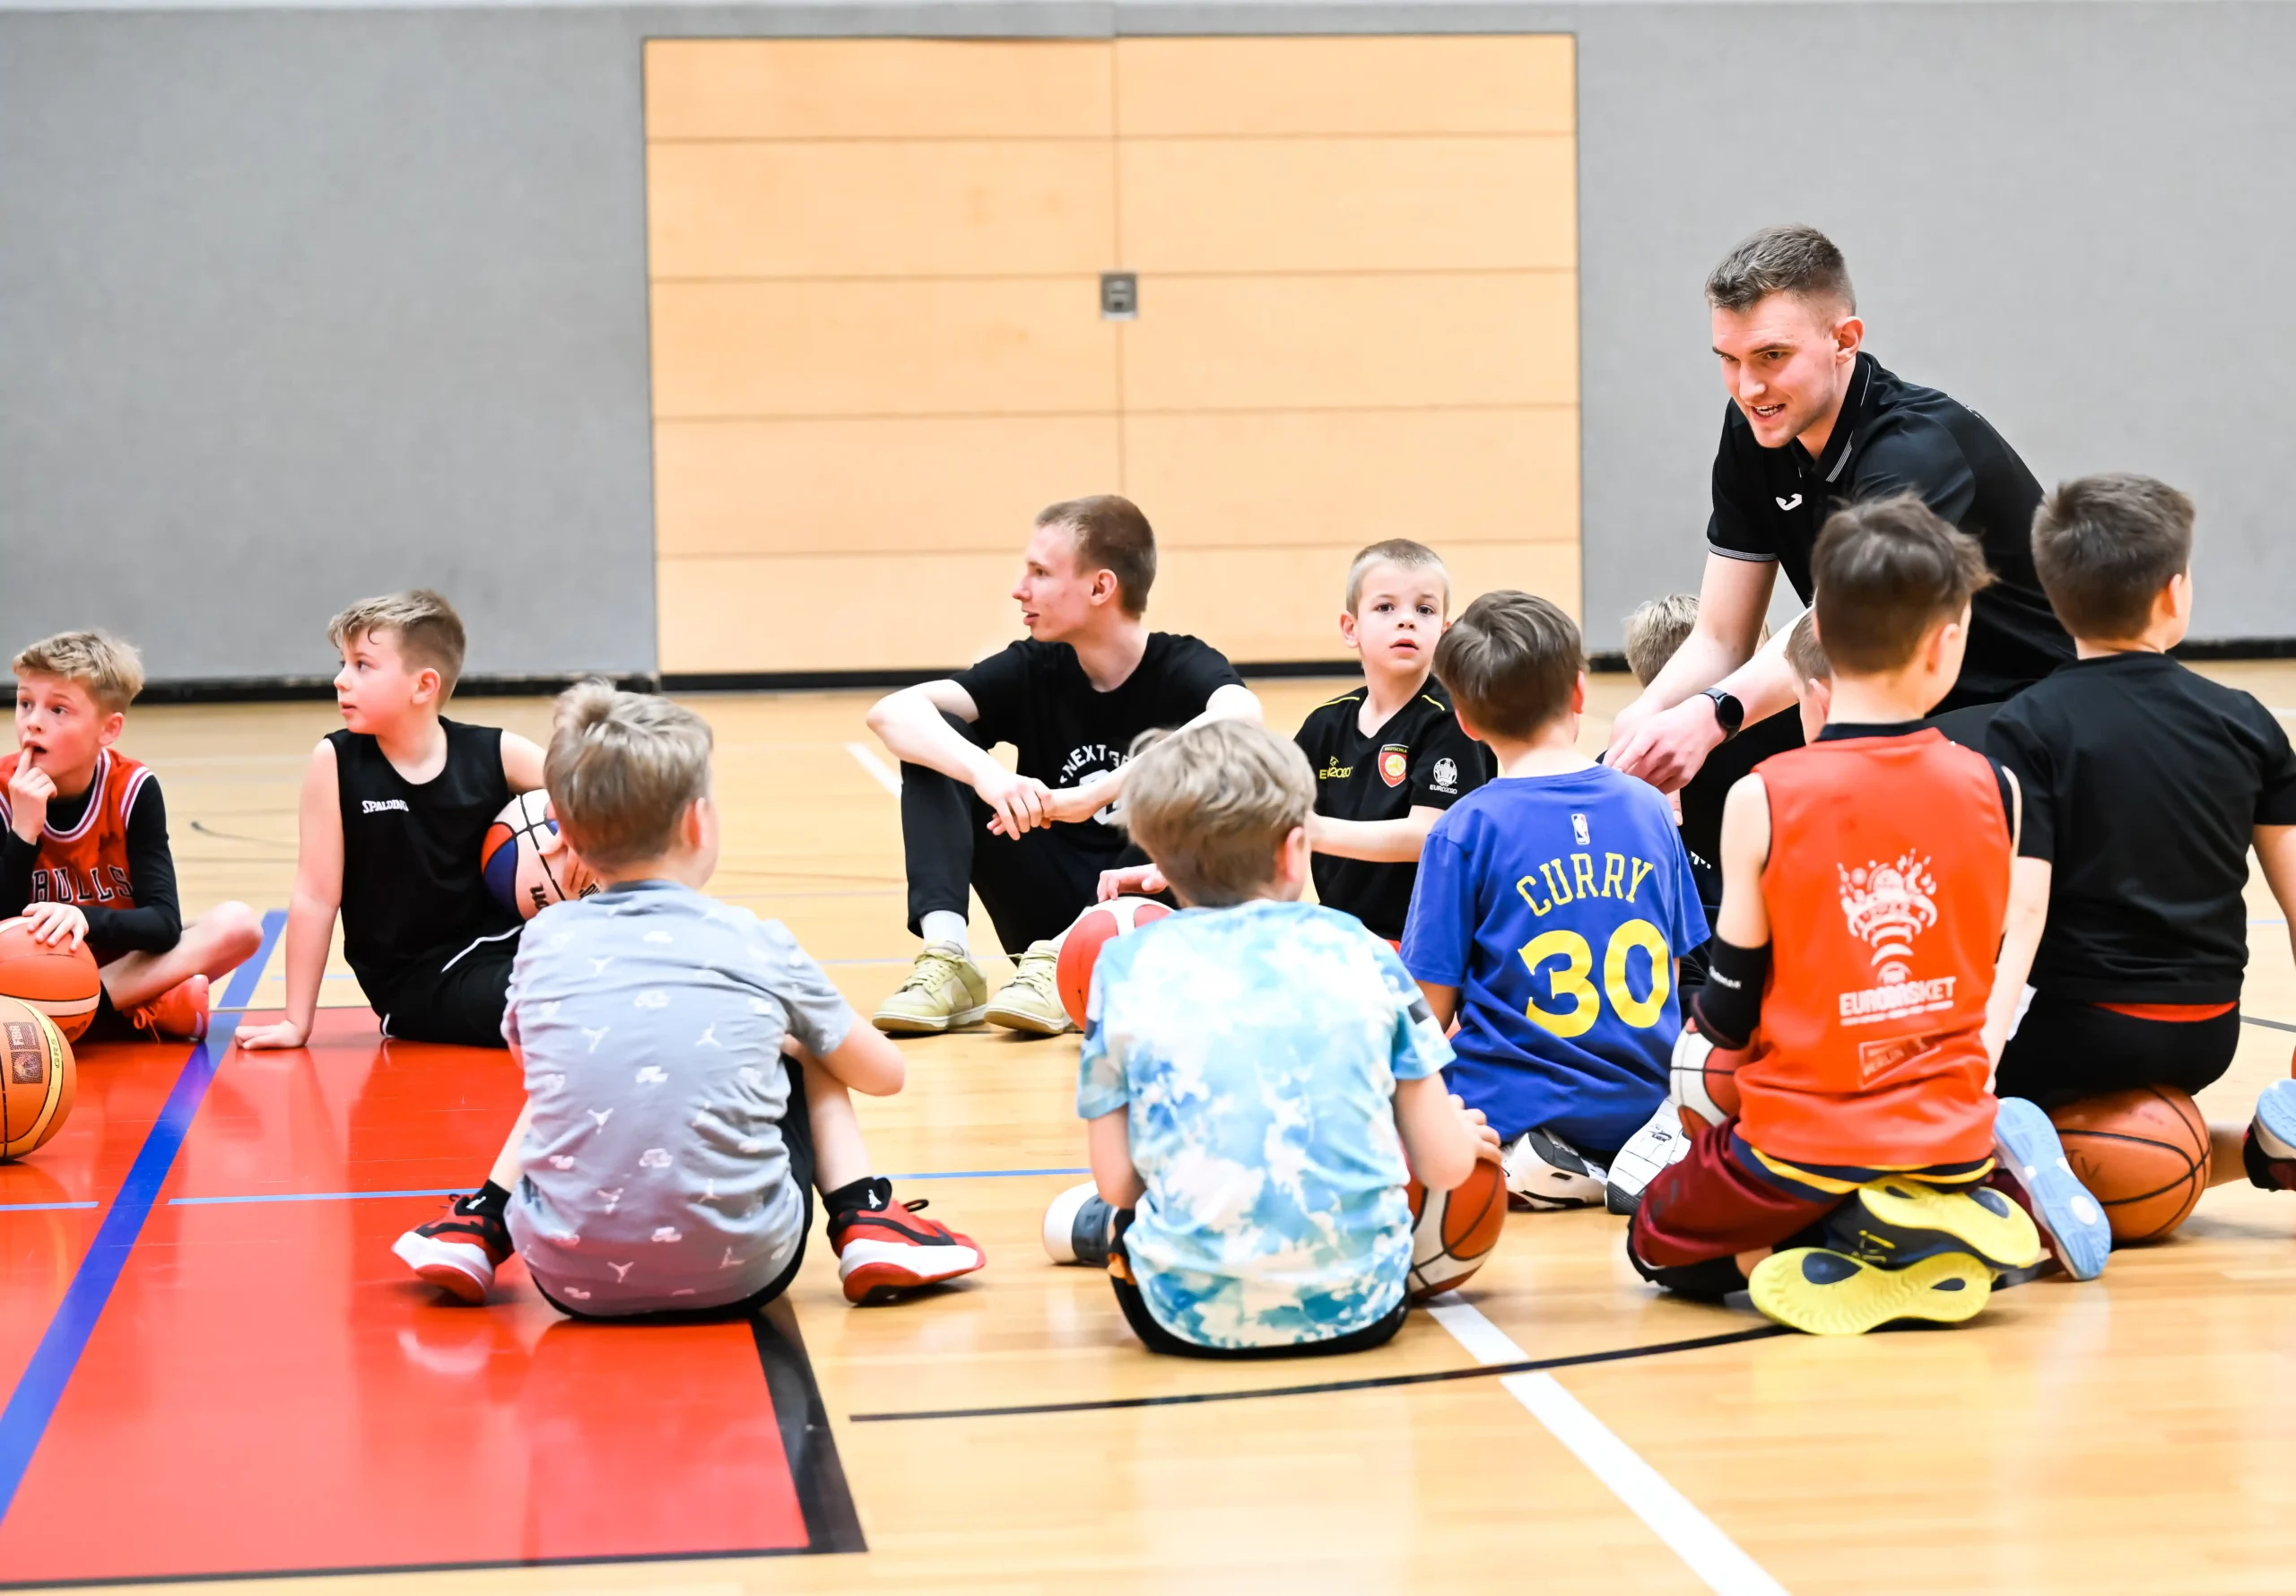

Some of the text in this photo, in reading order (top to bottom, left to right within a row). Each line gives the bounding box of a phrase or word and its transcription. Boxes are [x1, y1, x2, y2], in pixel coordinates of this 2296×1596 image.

[361, 799, 410, 814] SPALDING
[31, 864, 134, 904] BULLS
[1516, 853, 1654, 916] CURRY
[1518, 918, 1670, 1038] 30
